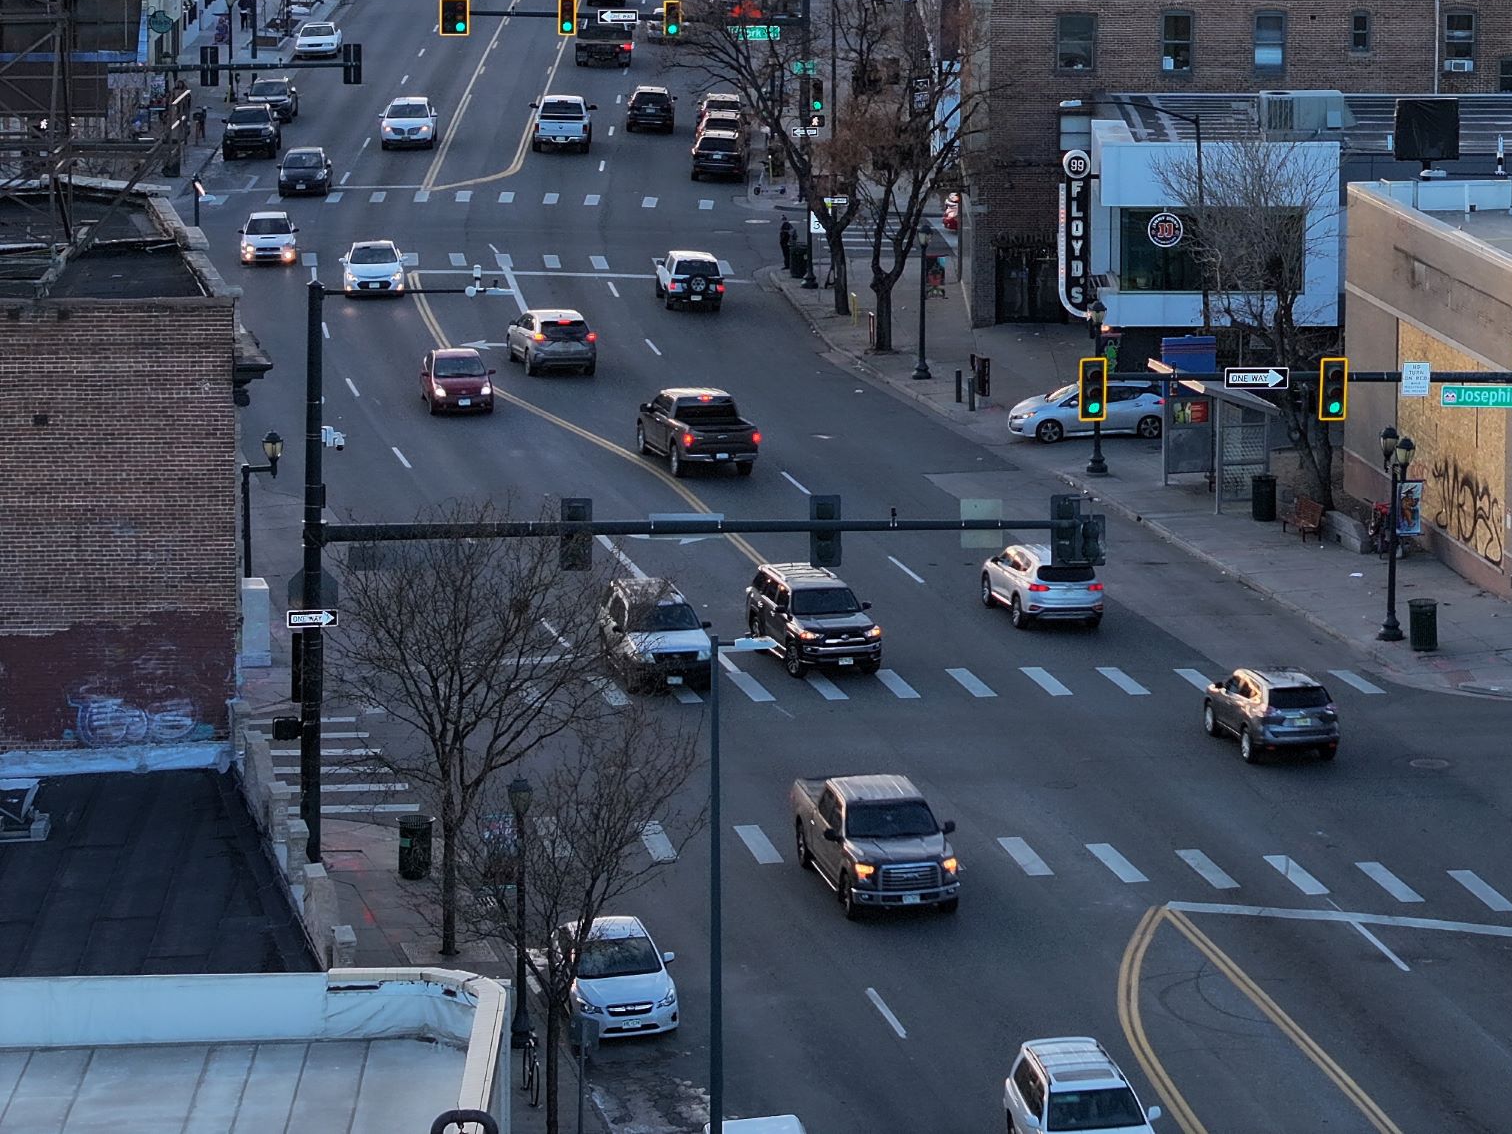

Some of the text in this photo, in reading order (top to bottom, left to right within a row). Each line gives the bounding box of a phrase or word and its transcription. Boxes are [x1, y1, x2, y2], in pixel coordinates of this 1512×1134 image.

[1070, 159, 1085, 172] 99
[1231, 374, 1269, 383] ONE WAY
